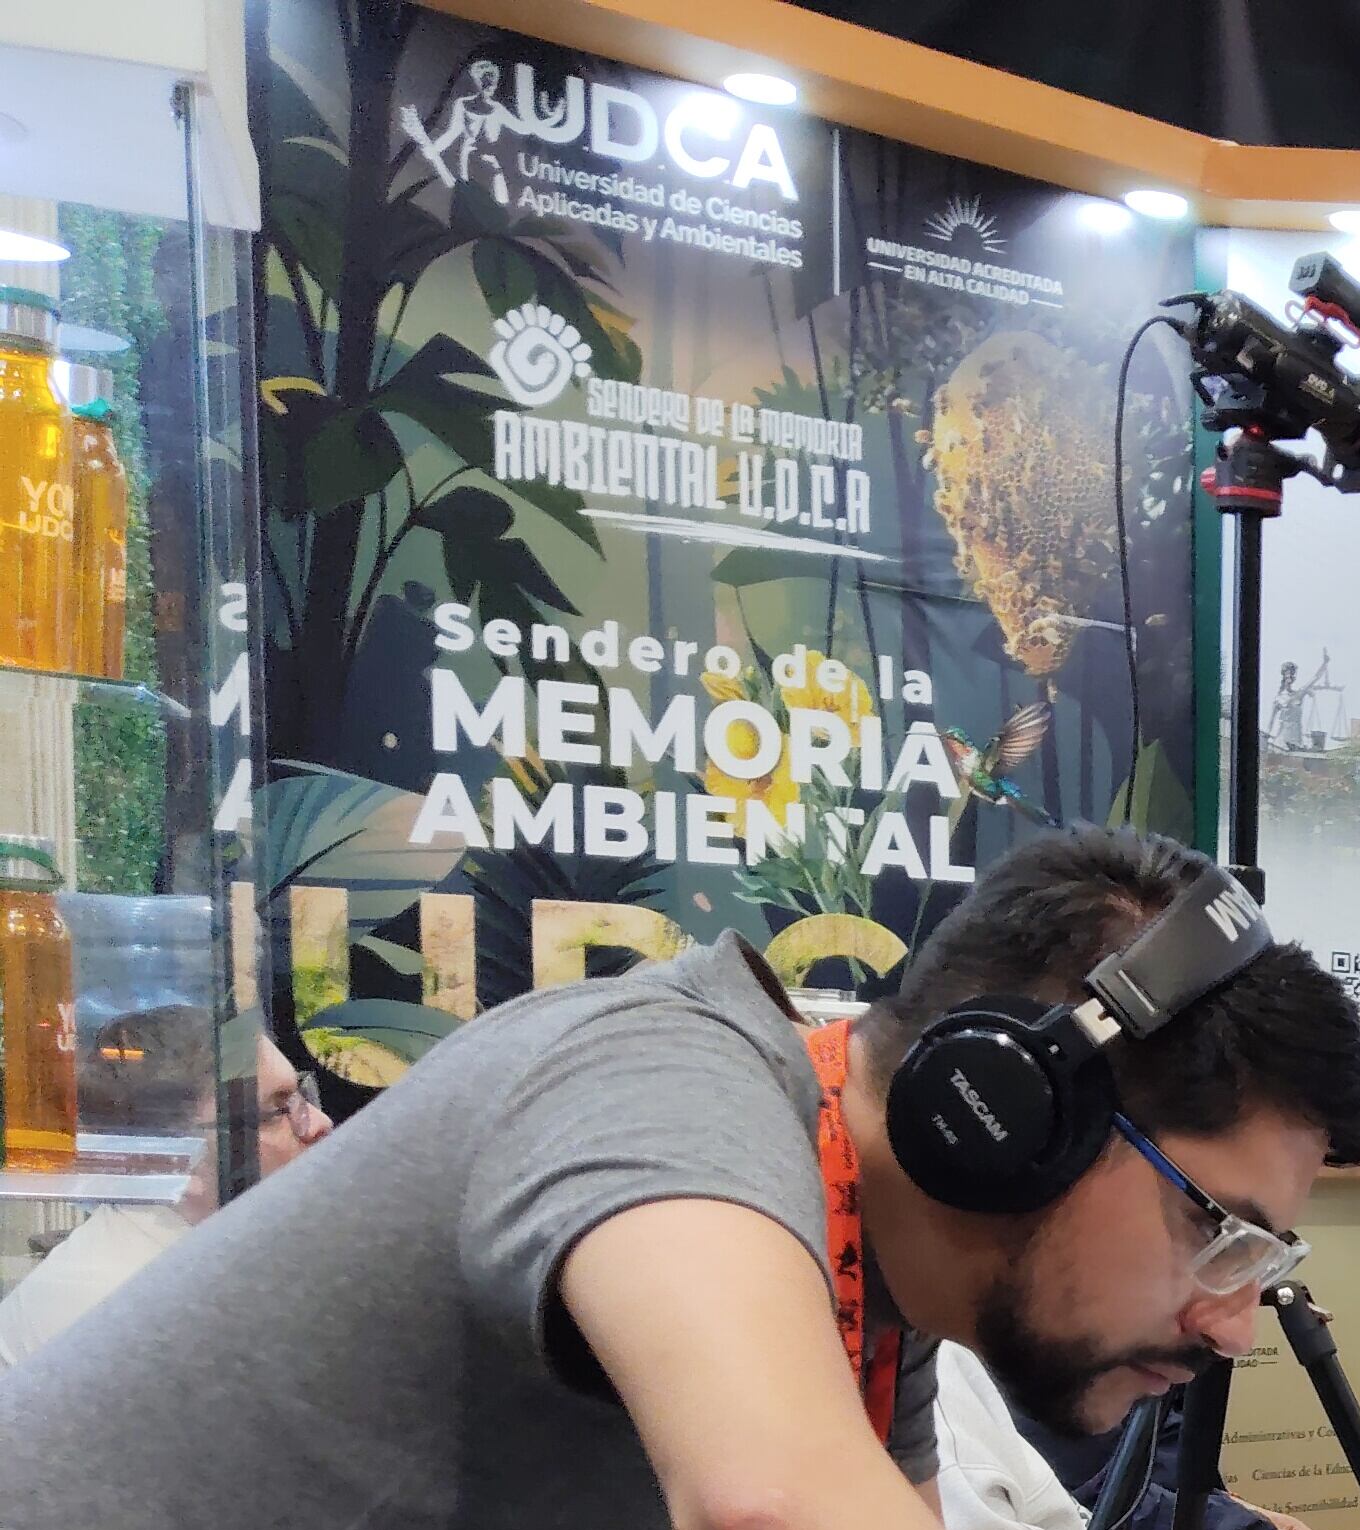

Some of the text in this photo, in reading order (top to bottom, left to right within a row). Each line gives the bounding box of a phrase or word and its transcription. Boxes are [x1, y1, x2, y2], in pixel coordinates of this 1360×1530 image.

[518, 151, 804, 239] Universidad de Ciencias
[518, 189, 804, 270] Aplicadas y Ambientales
[866, 237, 1064, 295] UNIVERSIDAD ACREDITADA
[903, 265, 1030, 305] EN ALTA CALIDAD
[433, 601, 934, 706] Sendero de la
[431, 668, 962, 801] MEMORIA
[408, 772, 977, 884] AMBIENTAL
[950, 1067, 1009, 1142] TASCAM
